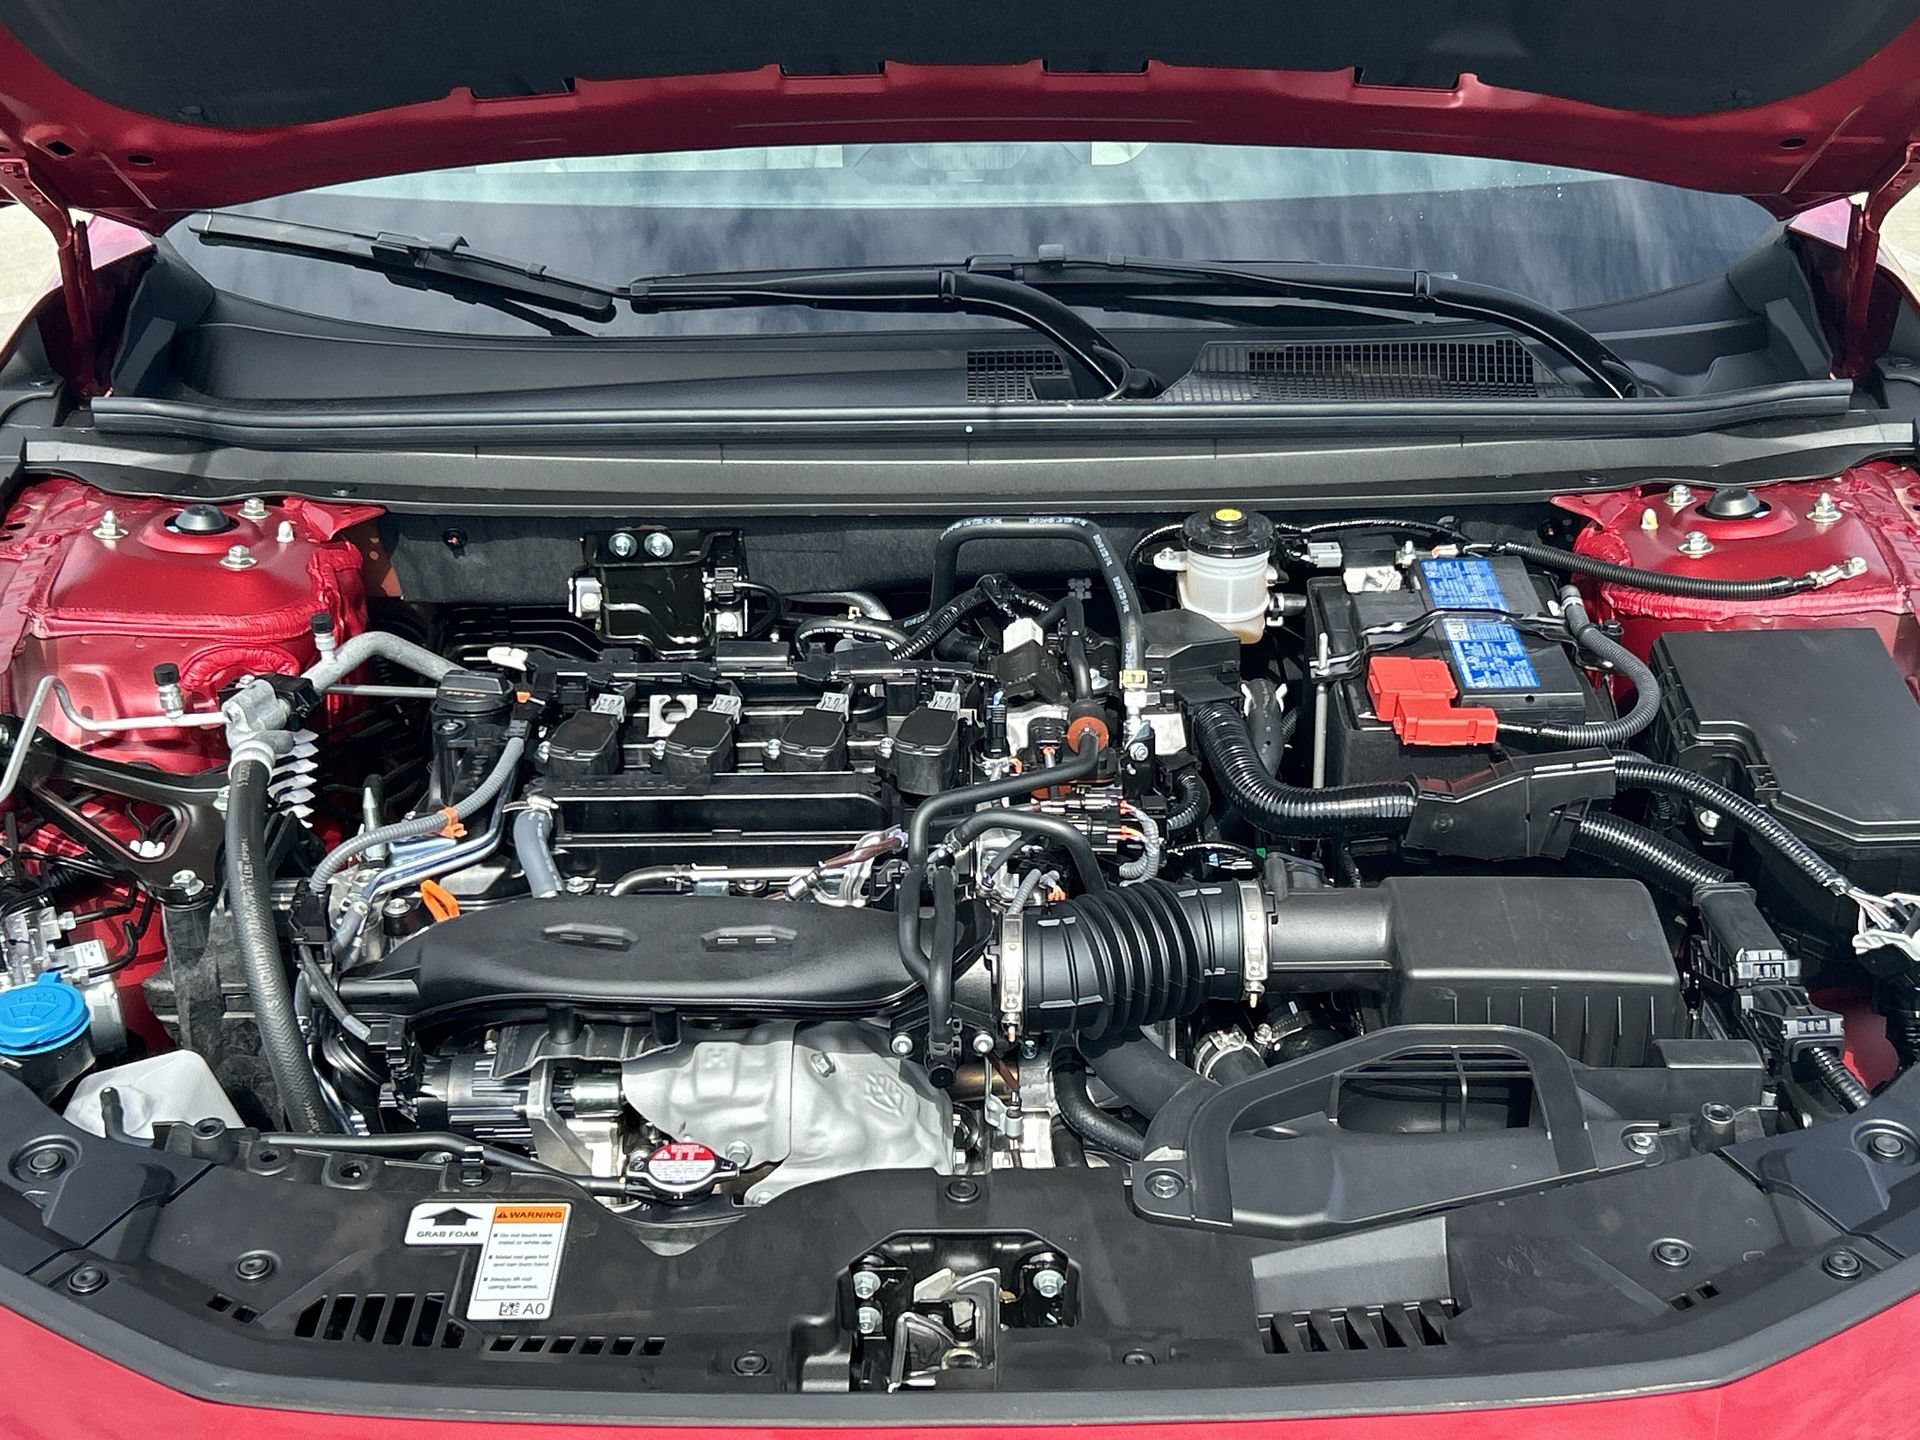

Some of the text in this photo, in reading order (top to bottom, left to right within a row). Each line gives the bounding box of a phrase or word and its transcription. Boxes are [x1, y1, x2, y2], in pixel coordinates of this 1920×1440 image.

[510, 1211, 562, 1219] WARNING
[416, 1230, 478, 1238] GRAB FOAM
[522, 1302, 545, 1315] A0
